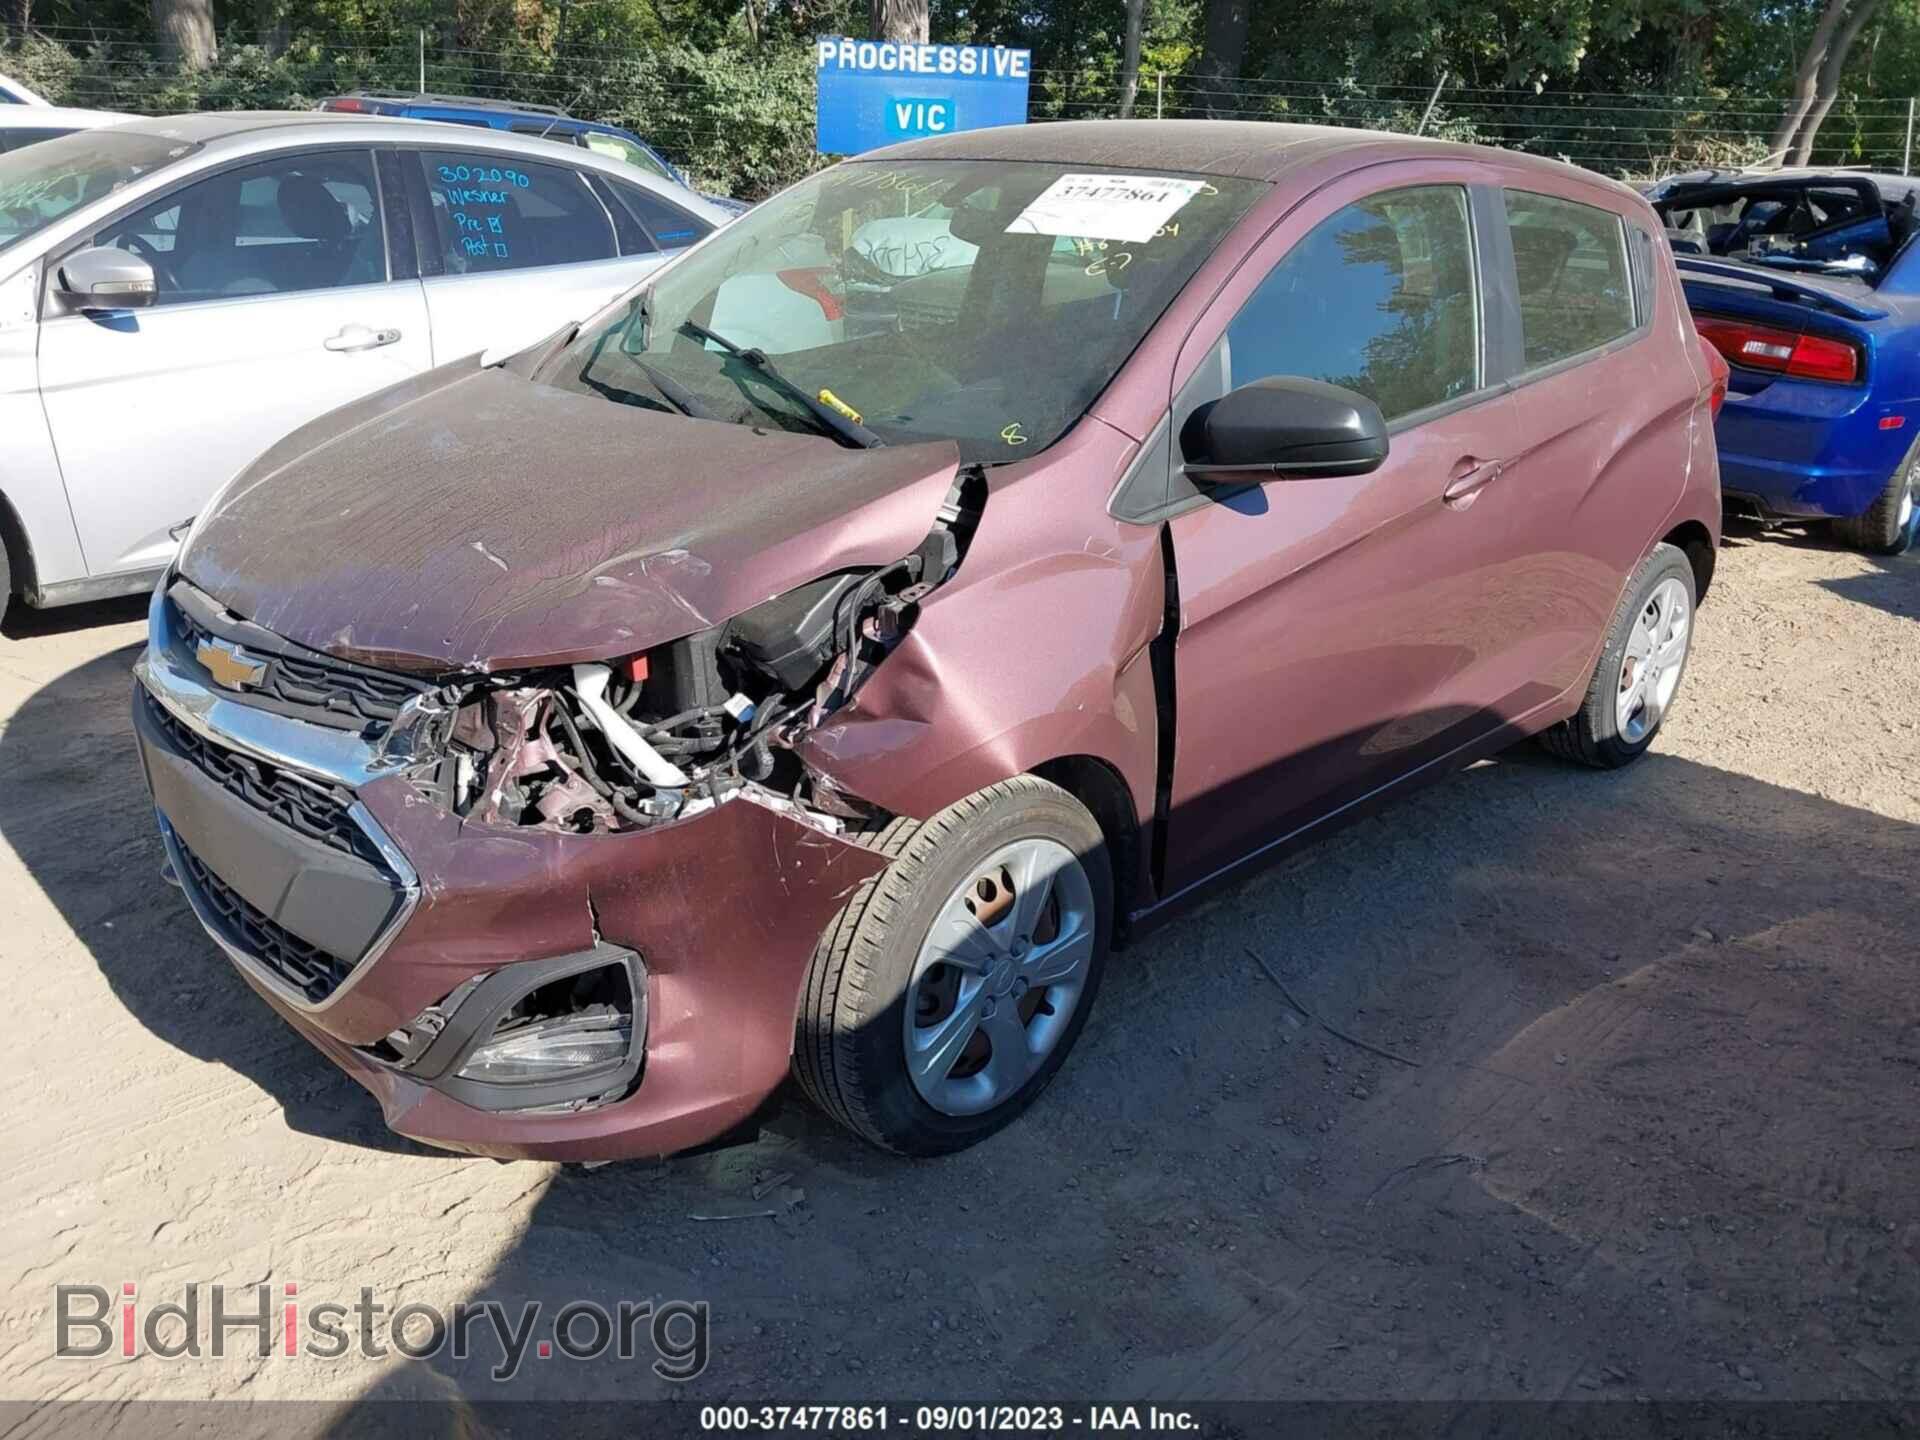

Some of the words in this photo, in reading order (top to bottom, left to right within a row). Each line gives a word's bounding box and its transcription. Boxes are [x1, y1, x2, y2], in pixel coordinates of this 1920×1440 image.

[818, 38, 1030, 78] PROGRESSIVE
[896, 103, 946, 131] VIC
[438, 166, 529, 188] 302090
[1056, 185, 1169, 203] 37477861
[454, 212, 482, 234] Pre
